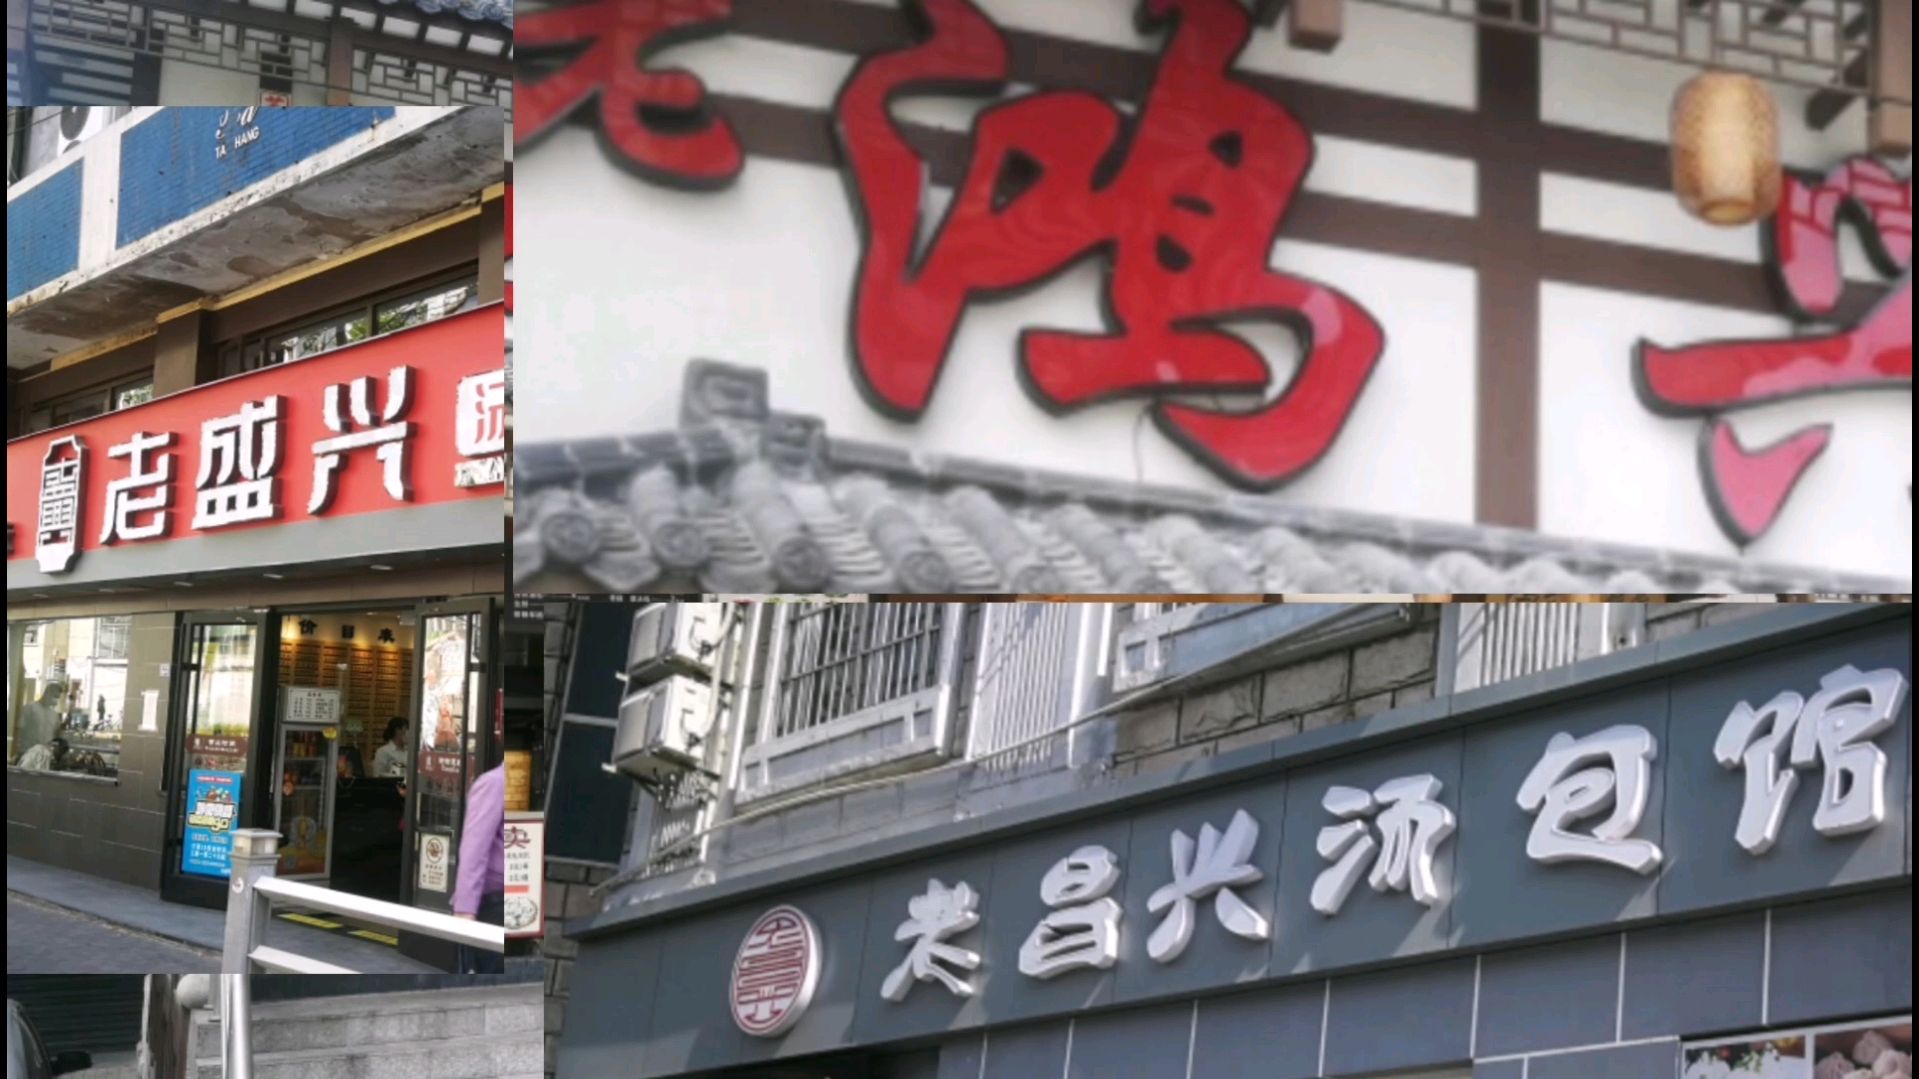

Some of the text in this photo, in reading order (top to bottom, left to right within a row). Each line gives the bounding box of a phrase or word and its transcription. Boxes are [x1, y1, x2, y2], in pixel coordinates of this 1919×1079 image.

[234, 125, 260, 149] HANG
[100, 365, 415, 545] 老盛兴
[881, 664, 1908, 1000] 老昌兴汤包馆
